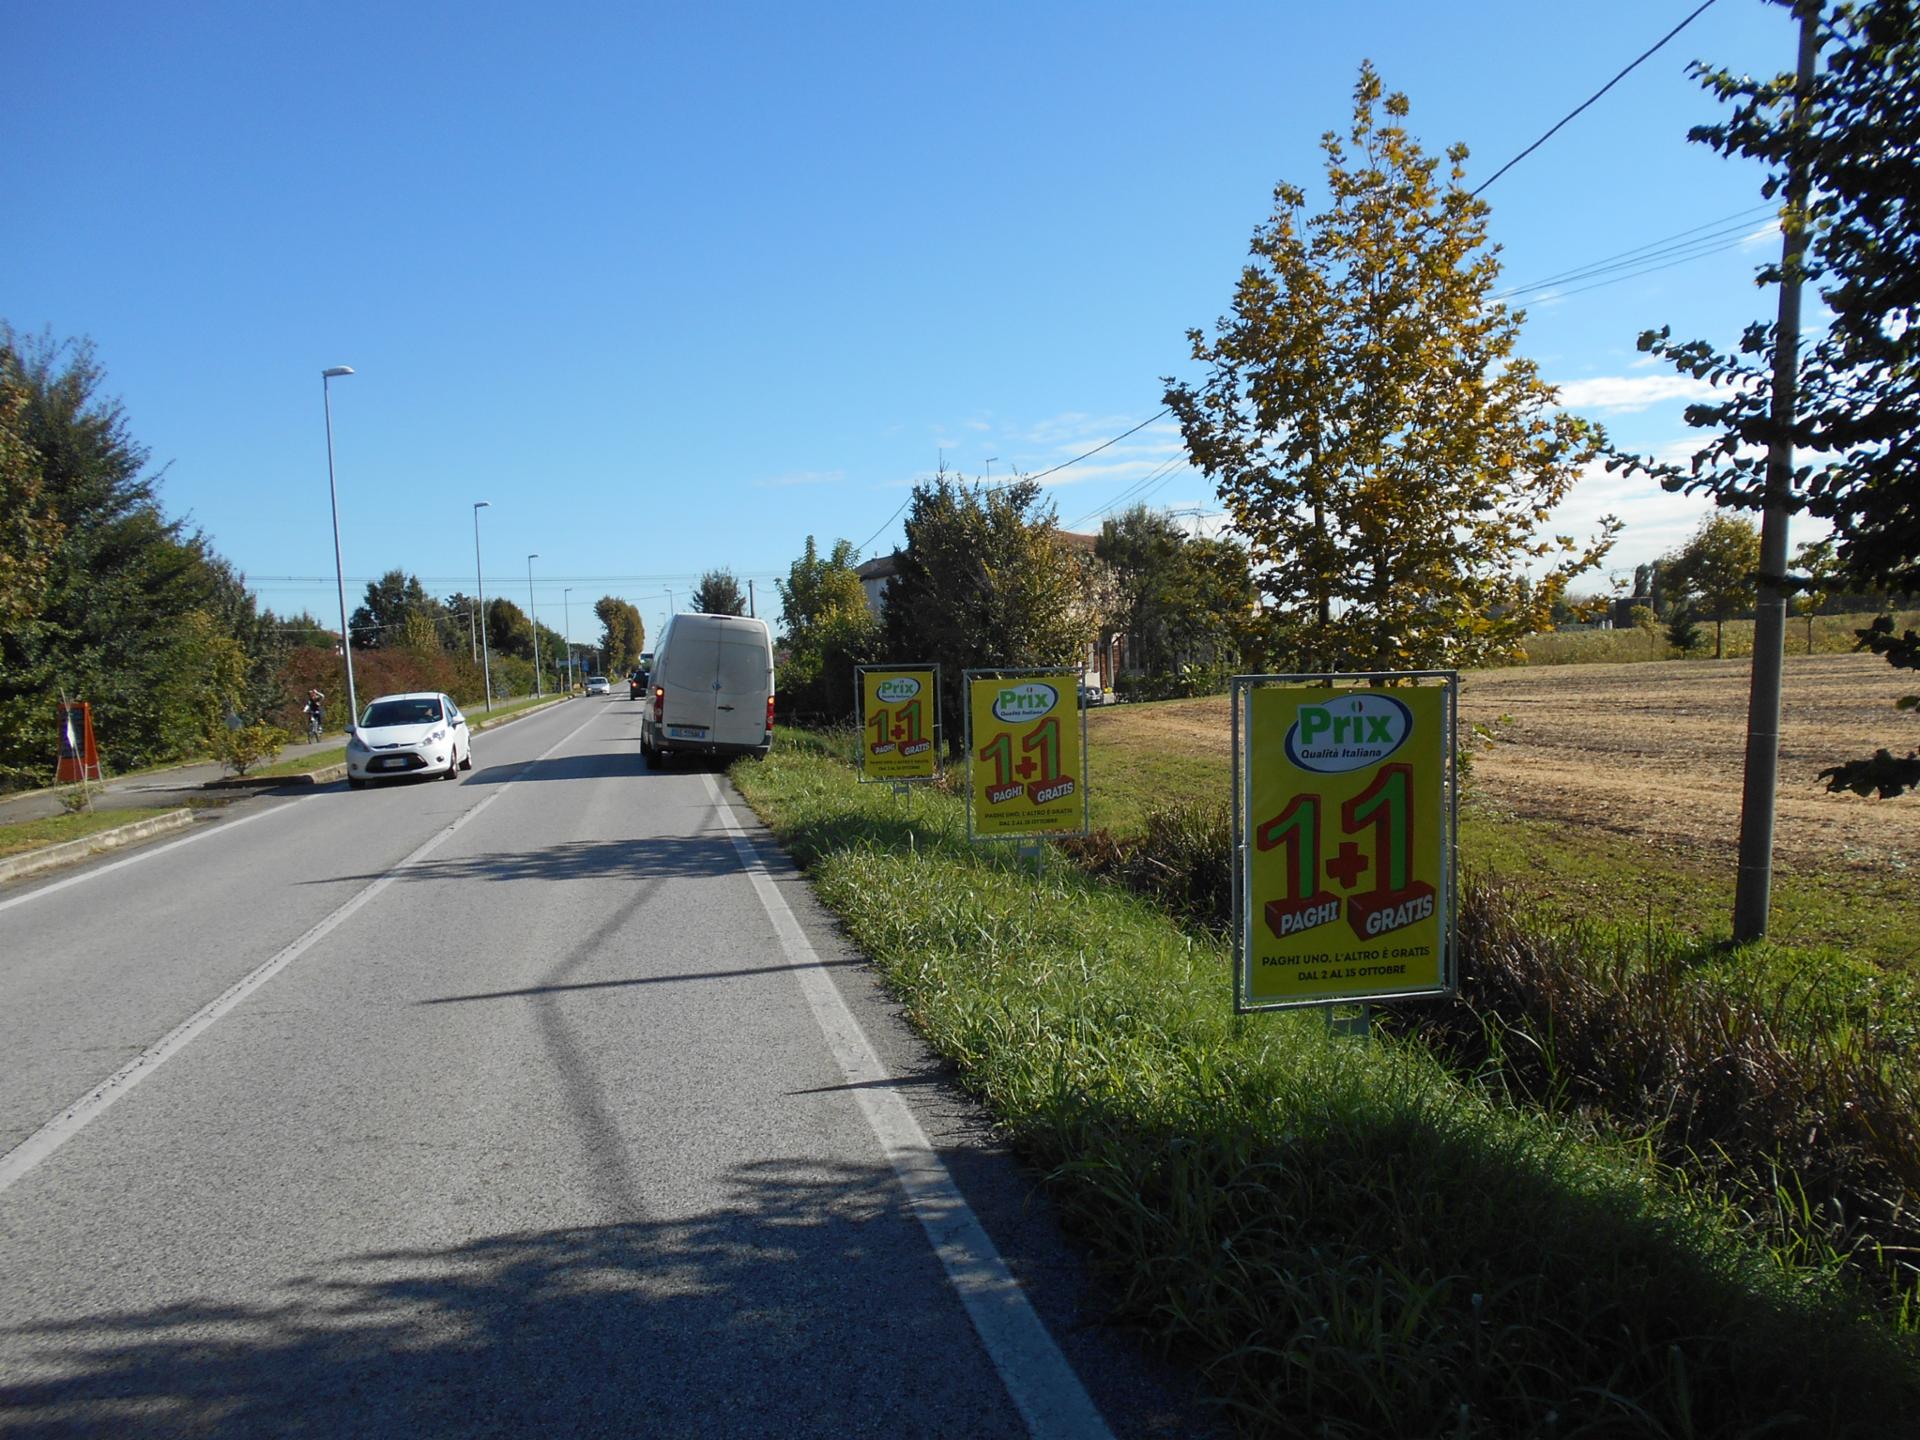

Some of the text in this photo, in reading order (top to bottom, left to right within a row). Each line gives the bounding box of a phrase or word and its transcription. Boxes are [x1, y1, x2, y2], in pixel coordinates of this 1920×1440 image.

[882, 680, 913, 693] Prix
[1000, 687, 1050, 709] Prix
[1300, 701, 1395, 745] Prix
[1301, 747, 1382, 759] Qualità Italiana
[993, 785, 1023, 803] PAGHI
[1037, 782, 1074, 802] GRATIS
[1280, 901, 1339, 936] PAGHI
[1366, 894, 1433, 935] GRATIS
[1262, 955, 1300, 966] PAGHI
[1335, 950, 1379, 962] L'ALTRO
[1382, 946, 1389, 958] È
[1391, 946, 1430, 958] GRATIS
[1298, 964, 1406, 980] DAL 2 AL 15 OTTOBRE
